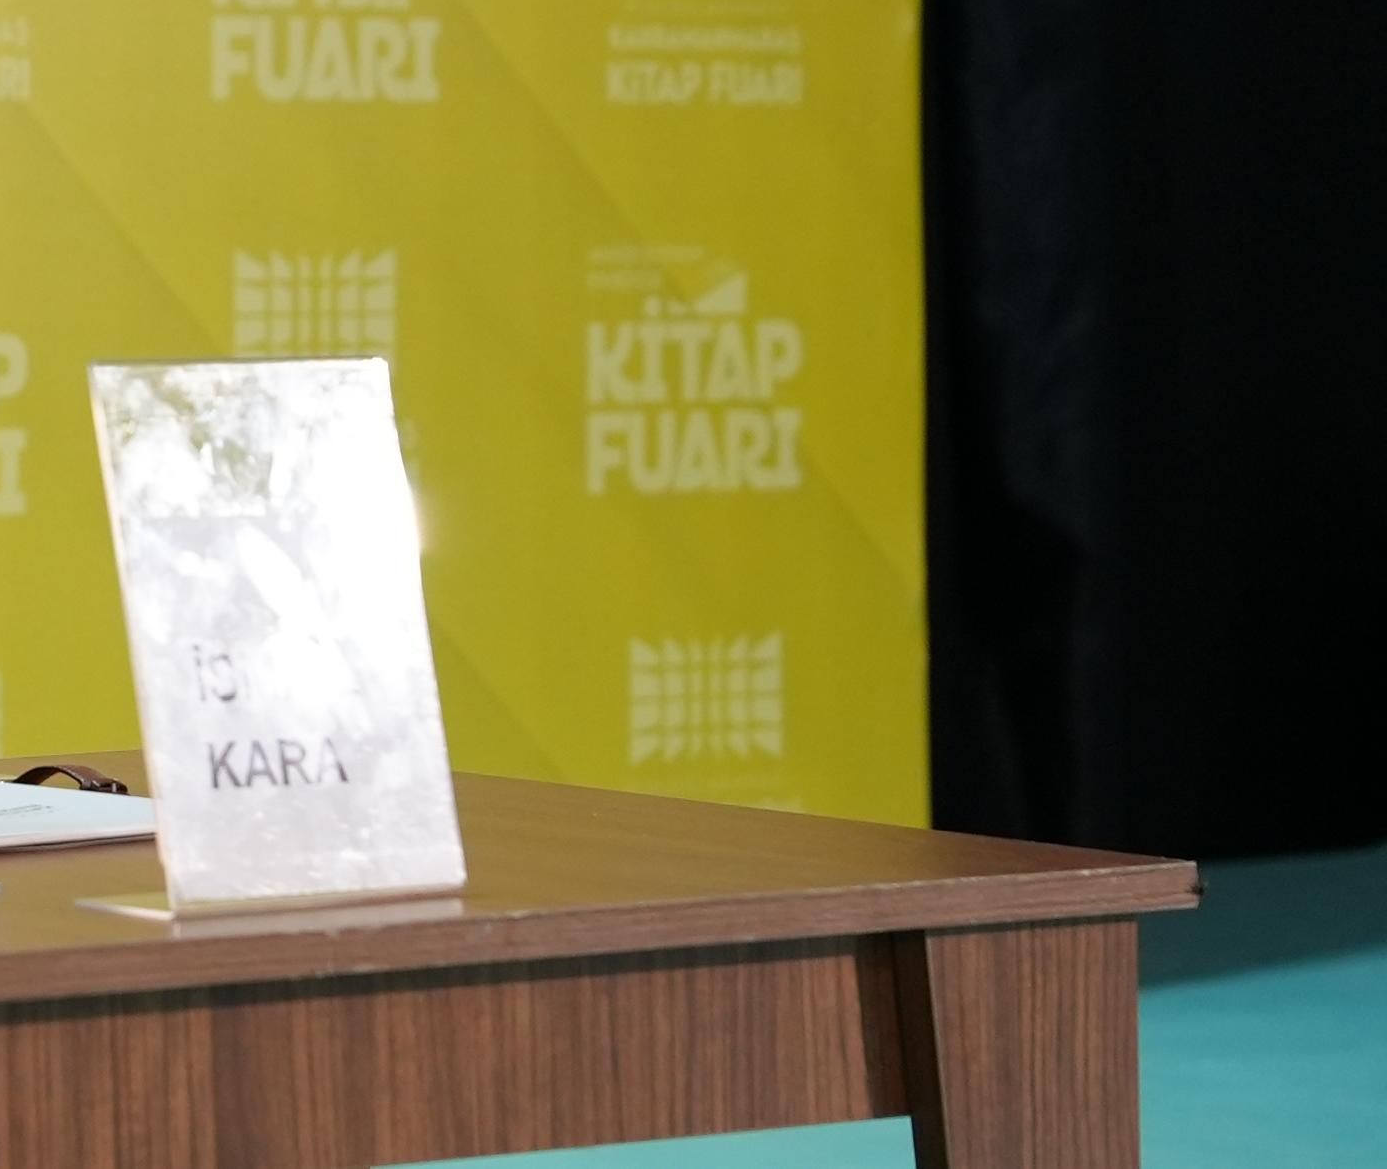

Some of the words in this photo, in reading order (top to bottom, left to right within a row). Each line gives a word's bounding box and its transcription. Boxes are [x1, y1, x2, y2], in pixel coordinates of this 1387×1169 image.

[211, 13, 442, 102] FUARI
[585, 407, 804, 497] FUARI
[207, 736, 349, 790] KARA
